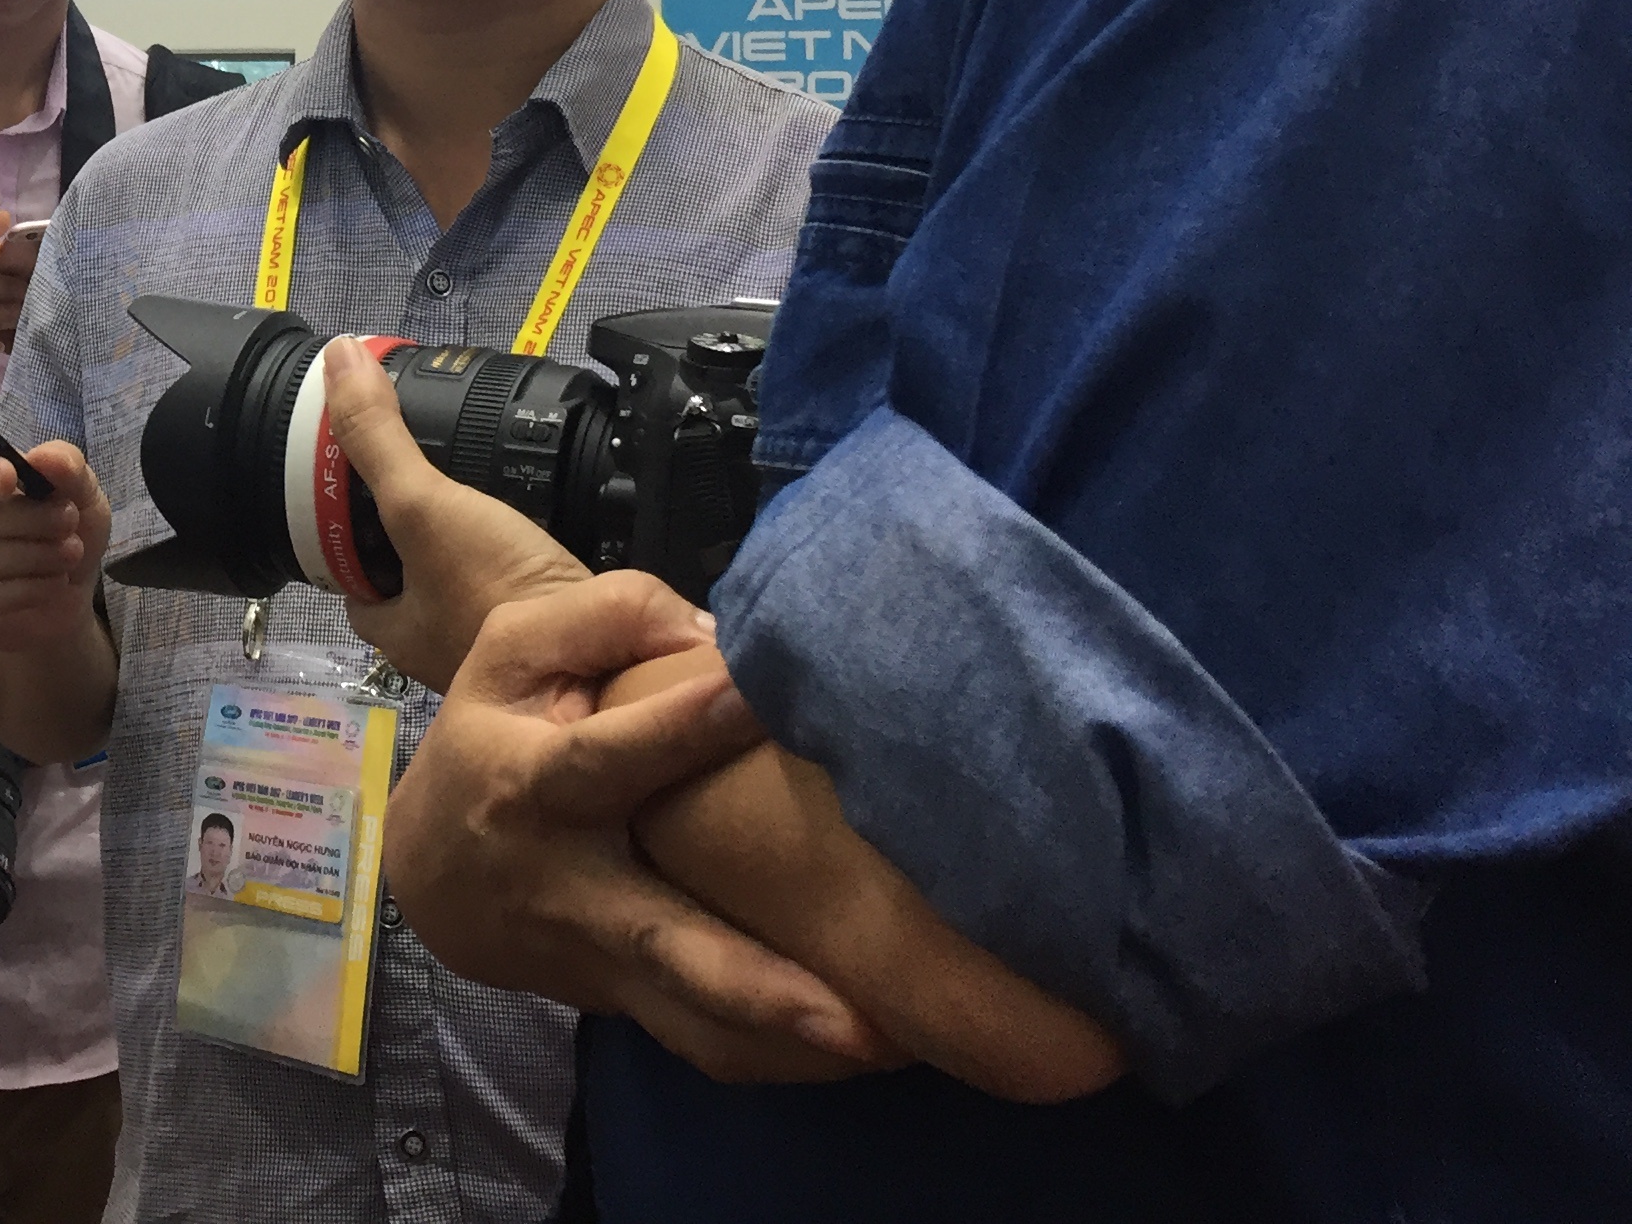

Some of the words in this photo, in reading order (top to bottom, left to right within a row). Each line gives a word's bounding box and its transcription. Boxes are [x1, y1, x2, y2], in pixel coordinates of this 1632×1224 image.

[276, 185, 290, 224] VIET
[575, 188, 606, 242] APEC
[268, 226, 285, 269] NAM
[555, 248, 582, 290] VIET
[531, 290, 561, 336] NAM
[323, 443, 340, 501] AF-S
[519, 464, 535, 475] VR
[347, 814, 378, 962] PRESS
